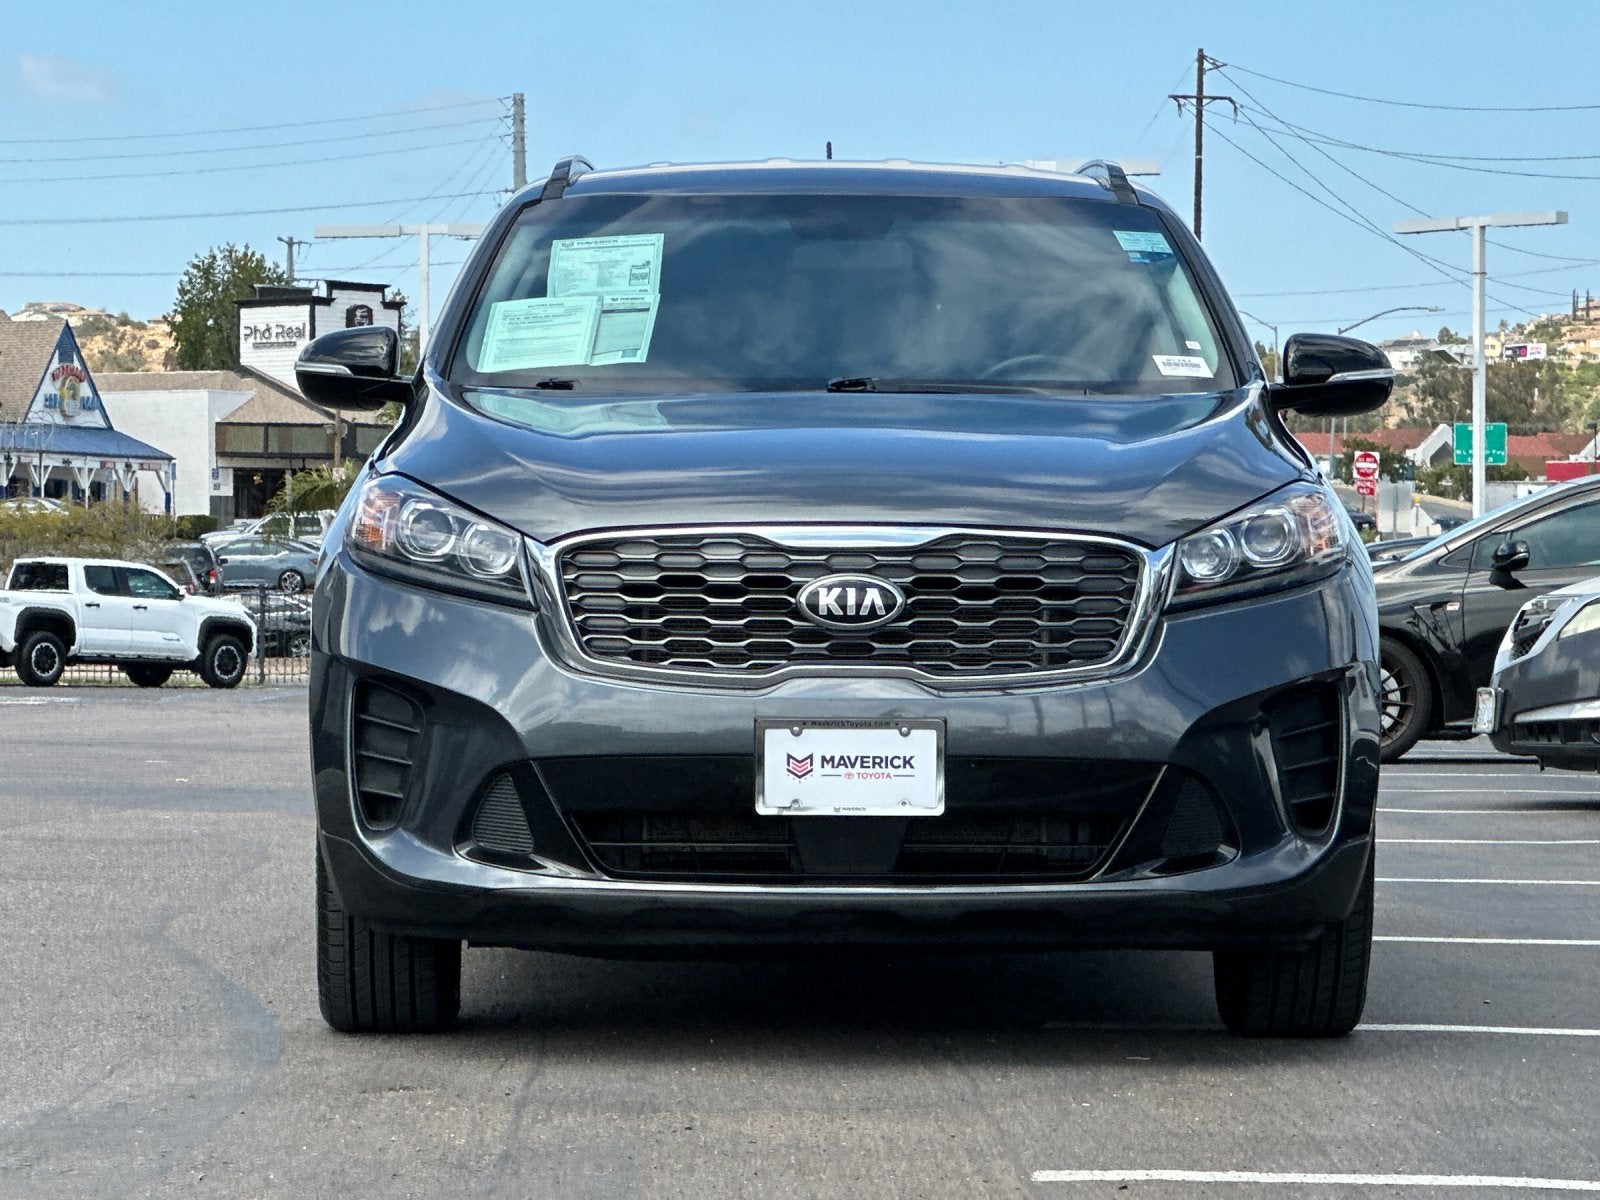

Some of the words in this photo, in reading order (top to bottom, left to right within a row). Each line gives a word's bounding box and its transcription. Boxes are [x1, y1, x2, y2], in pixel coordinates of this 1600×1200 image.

[275, 322, 306, 340] Real
[818, 587, 886, 616] KIA
[811, 720, 891, 728] MaverickToyota.com
[820, 755, 915, 769] MAVERICK
[856, 772, 892, 780] TOYOTA
